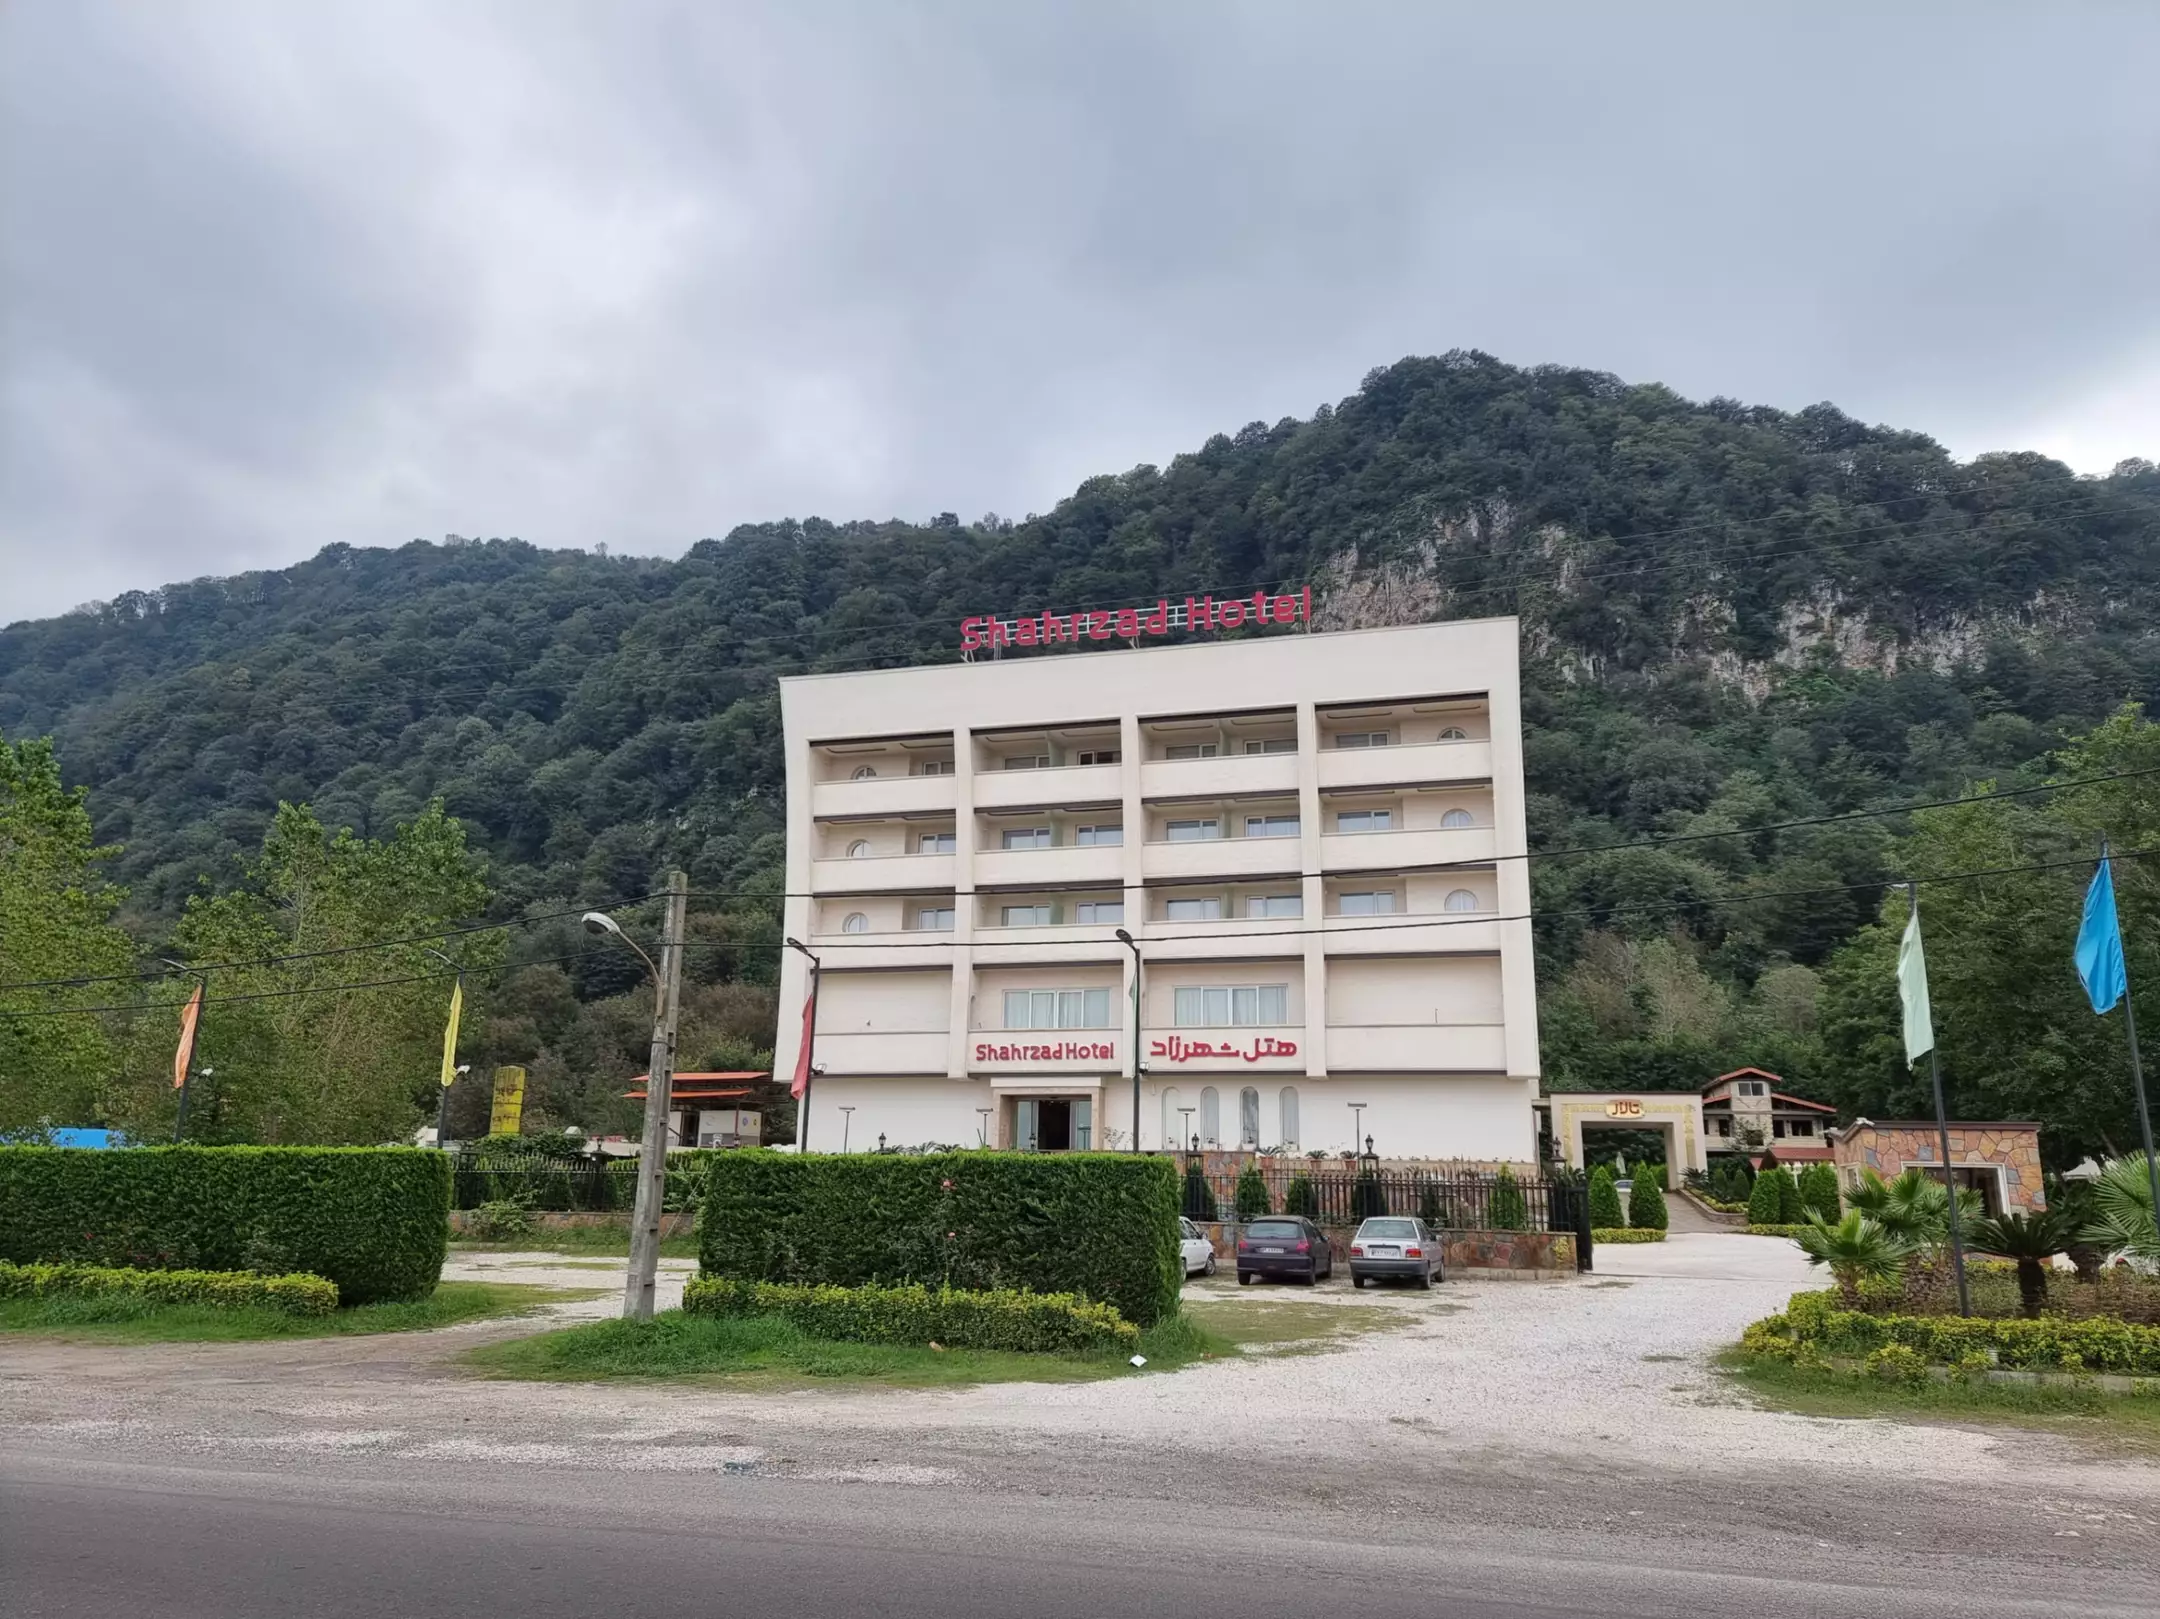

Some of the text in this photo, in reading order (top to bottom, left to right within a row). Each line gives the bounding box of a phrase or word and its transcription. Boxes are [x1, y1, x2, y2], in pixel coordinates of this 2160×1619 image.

[960, 585, 1311, 652] Shahrzad Hotel
[975, 1042, 1114, 1061] Shahrzad Hotel
[1149, 1035, 1297, 1063] هتل شهرزاد
